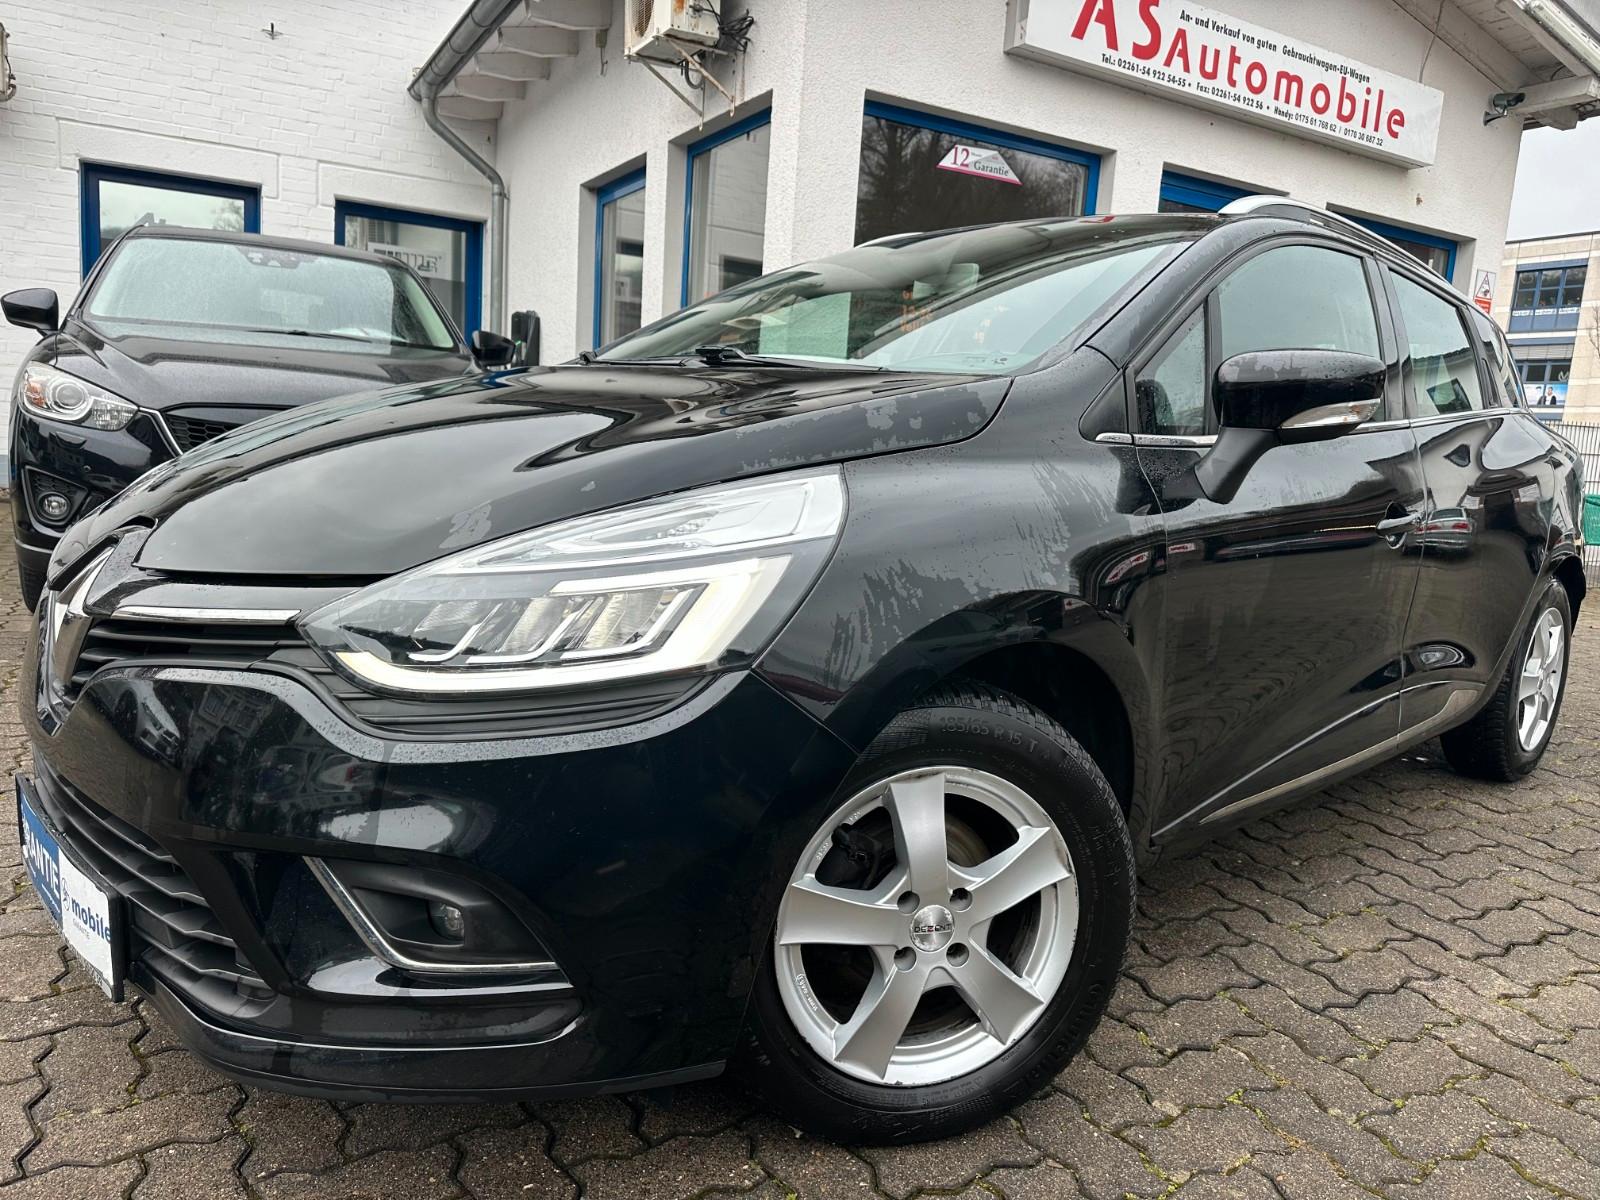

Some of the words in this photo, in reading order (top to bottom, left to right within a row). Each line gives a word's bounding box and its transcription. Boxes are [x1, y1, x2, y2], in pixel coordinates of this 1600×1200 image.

[1180, 9, 1193, 23] An-
[1195, 17, 1210, 29] und
[1211, 19, 1241, 39] Verkauf
[1242, 32, 1255, 45] von
[1256, 39, 1277, 52] guten
[1117, 58, 1151, 76] 02261-54
[1152, 70, 1166, 81] 922
[1166, 74, 1187, 87] 54-55
[1196, 82, 1210, 94] Fax:
[1211, 86, 1241, 103] 02261-54
[1242, 96, 1255, 108] 922
[1255, 100, 1264, 110] 56
[1273, 105, 1294, 121] Handy:
[950, 146, 970, 168] 12
[973, 161, 1009, 177] Garantie
[71, 897, 112, 944] mobile
[914, 923, 952, 933] DEZENT
